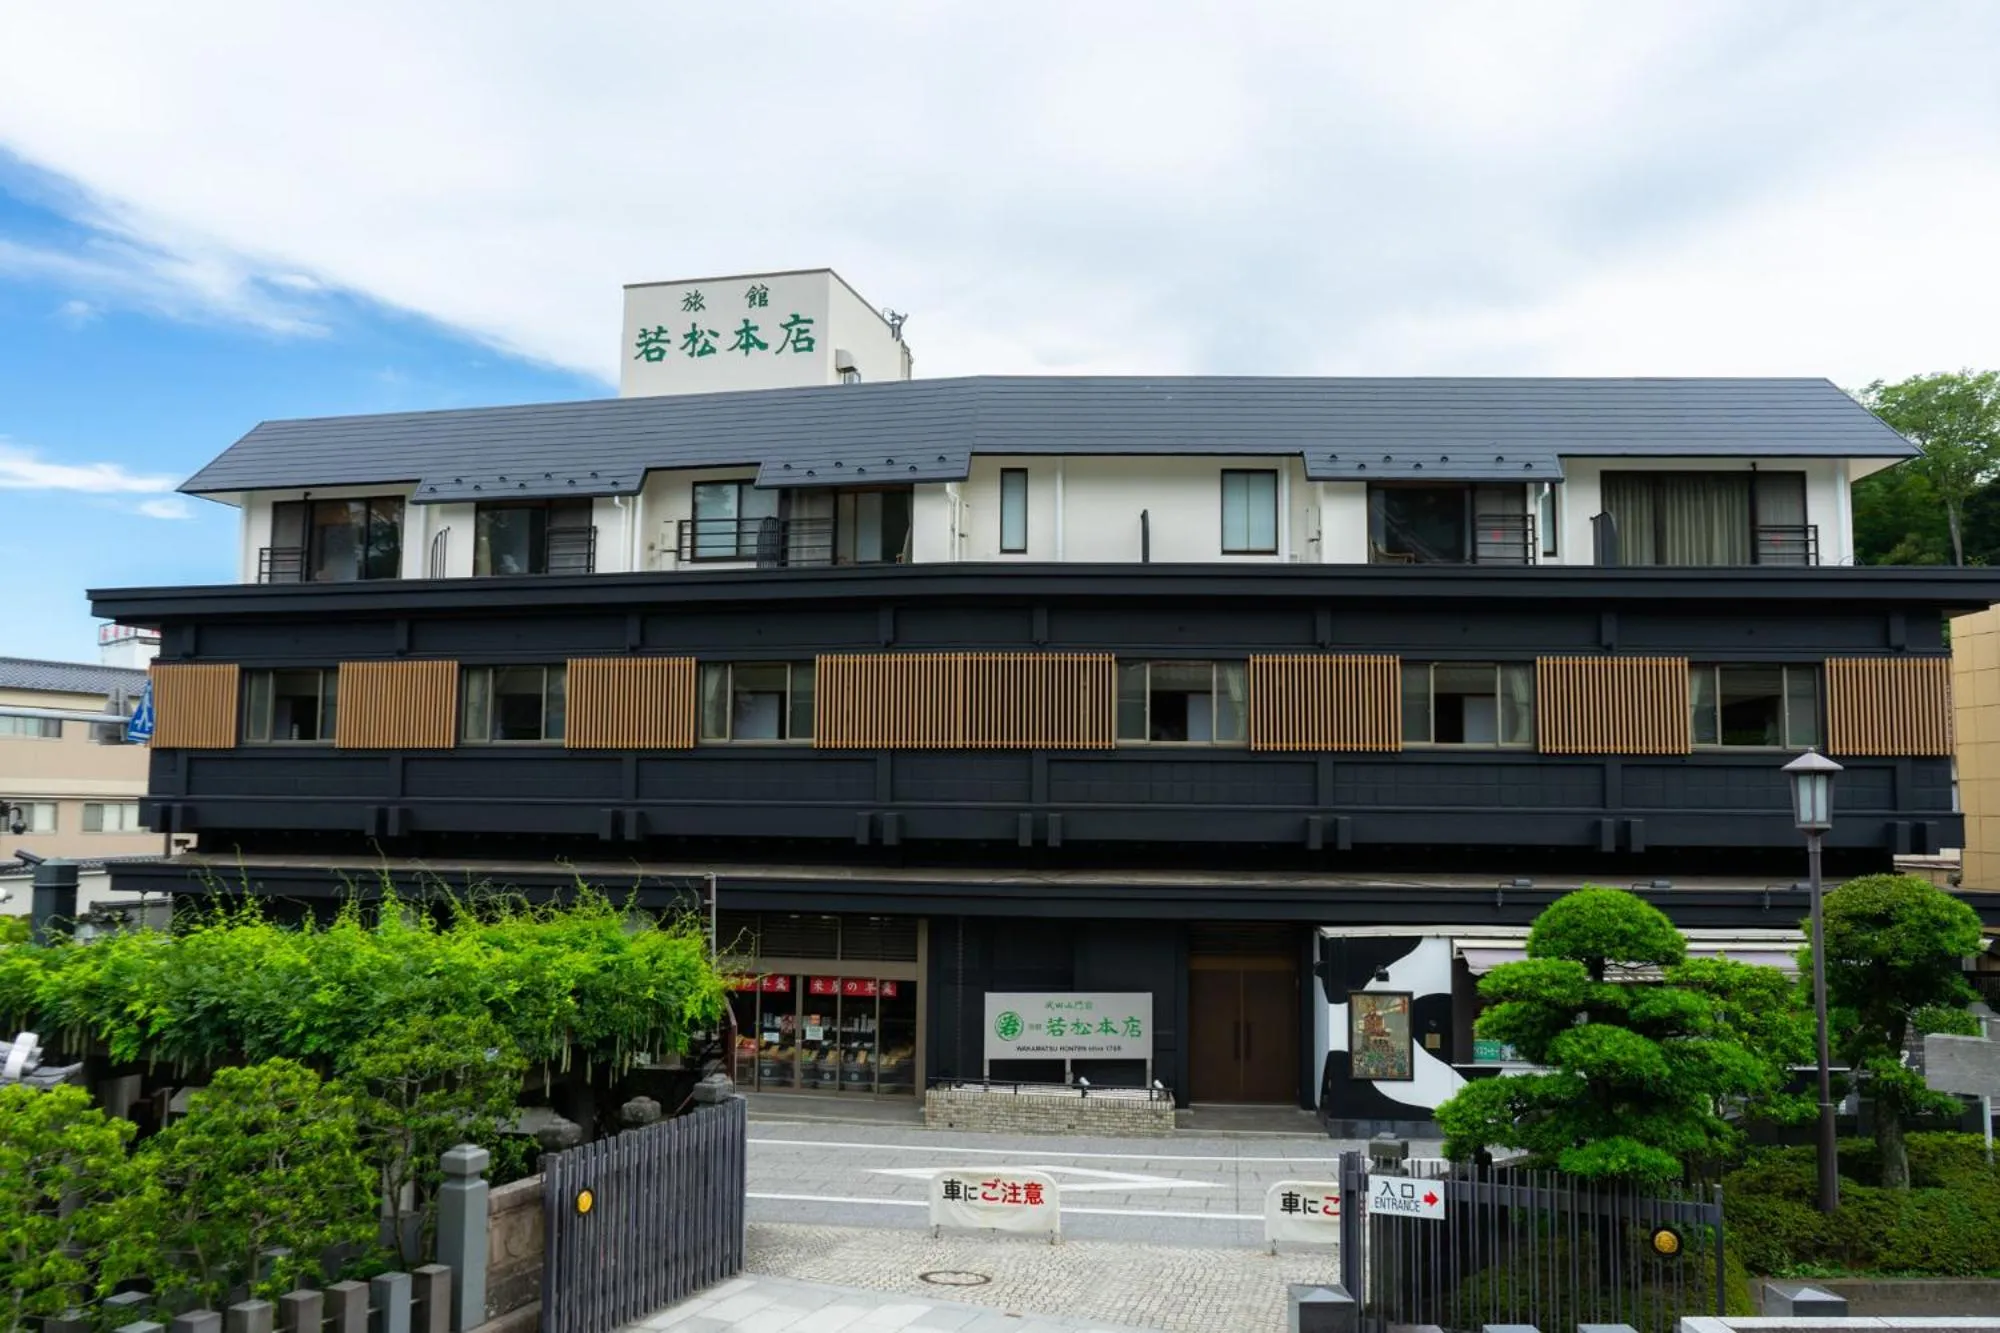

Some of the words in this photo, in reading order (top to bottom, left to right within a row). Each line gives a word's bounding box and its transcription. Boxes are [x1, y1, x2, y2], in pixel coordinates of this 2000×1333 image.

[680, 283, 770, 312] 旅館
[634, 313, 816, 363] 若松本店
[1046, 1015, 1142, 1038] 若松本店
[1016, 1044, 1058, 1052] WAKAMATSU
[942, 1179, 1044, 1205] 車にご注意
[1380, 1181, 1415, 1199] 入口
[1374, 1196, 1421, 1213] ENTRANCE
